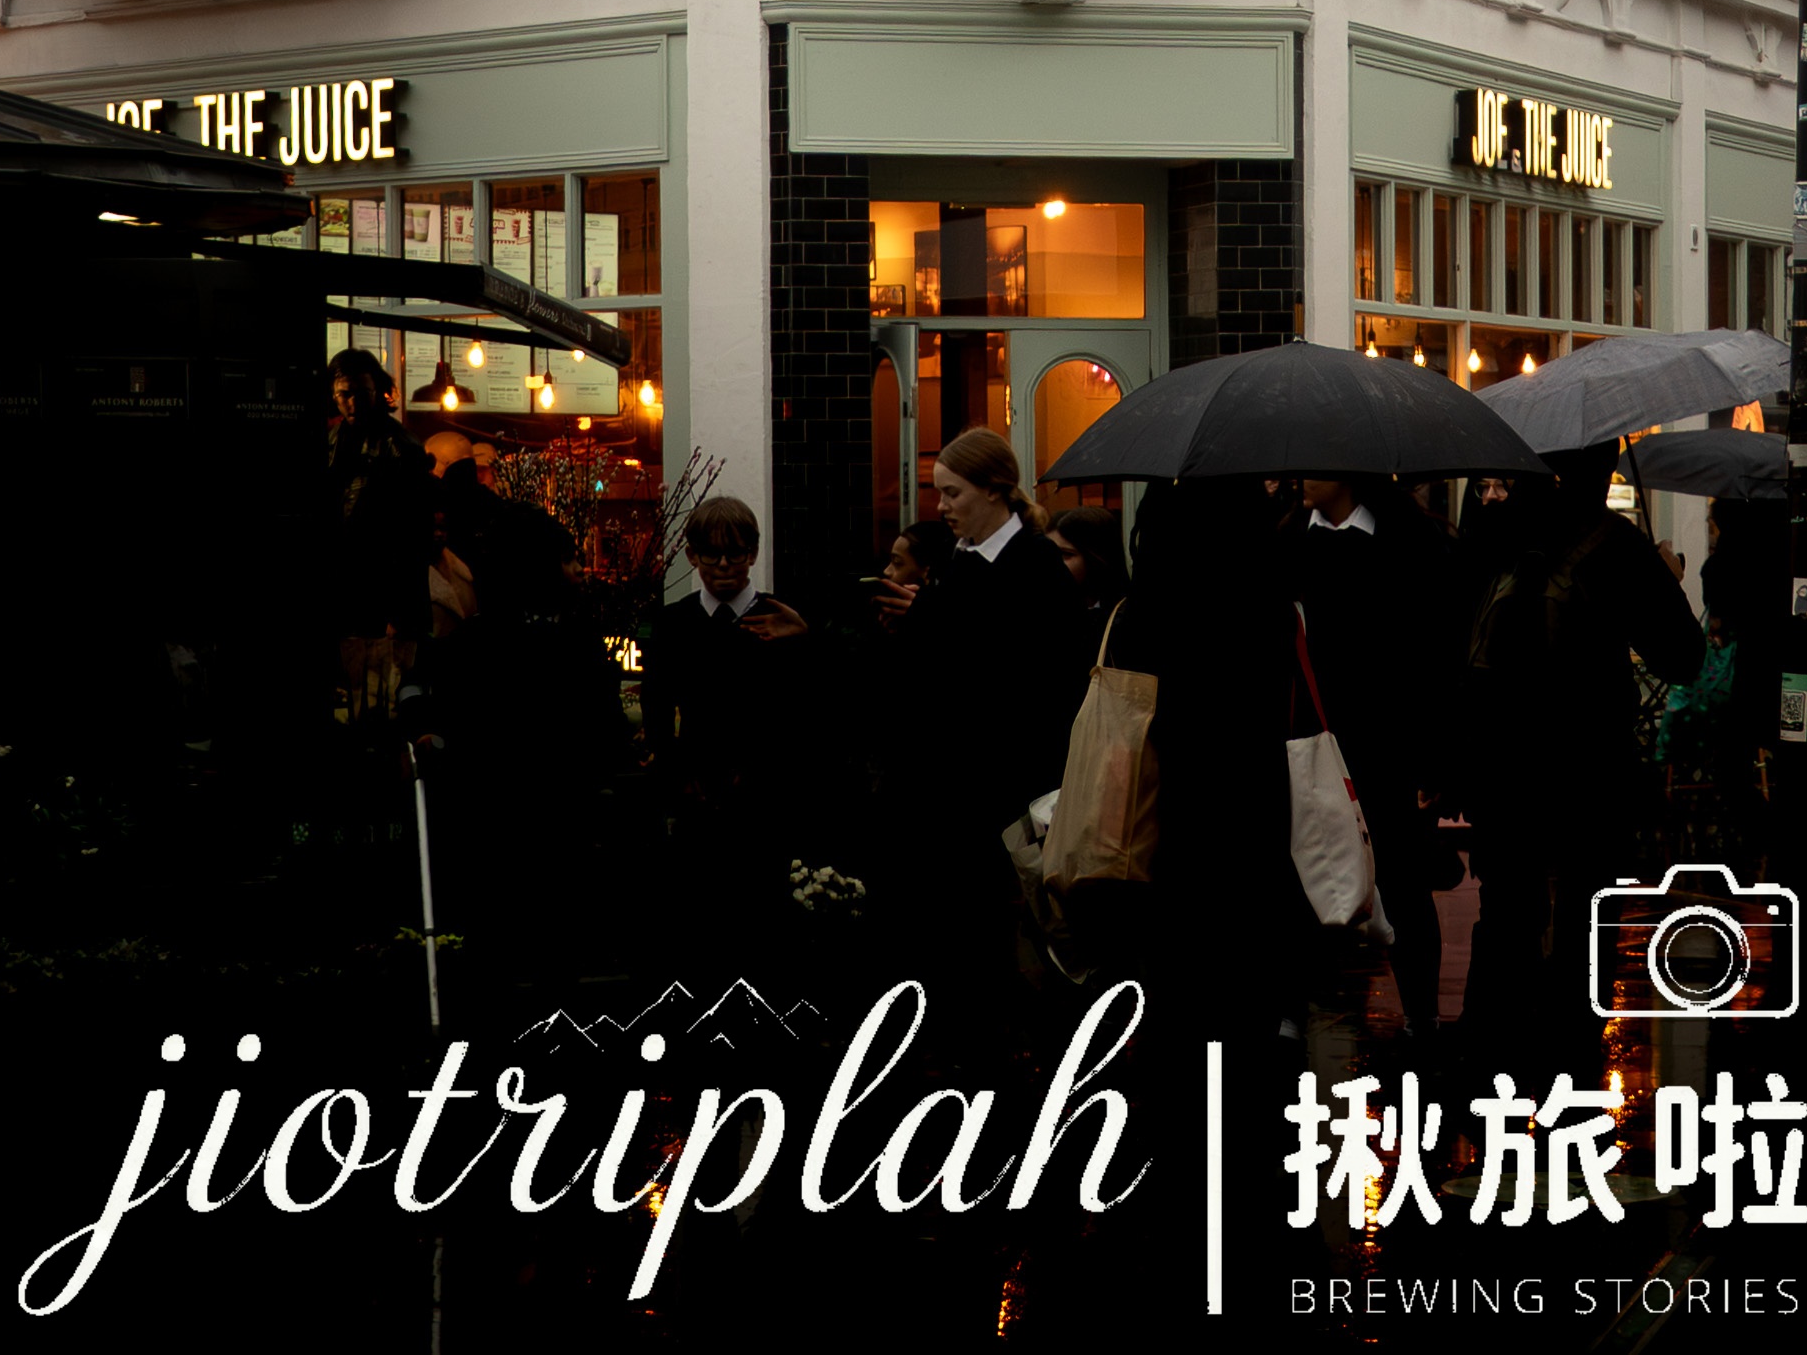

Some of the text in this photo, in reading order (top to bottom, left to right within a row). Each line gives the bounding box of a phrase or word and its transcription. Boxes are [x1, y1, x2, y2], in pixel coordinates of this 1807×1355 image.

[278, 77, 396, 167] JUICE
[1471, 87, 1509, 170] JOE
[1521, 98, 1558, 180] THE
[1561, 108, 1614, 190] JUICE
[91, 397, 185, 407] ANTONY ROBERTS
